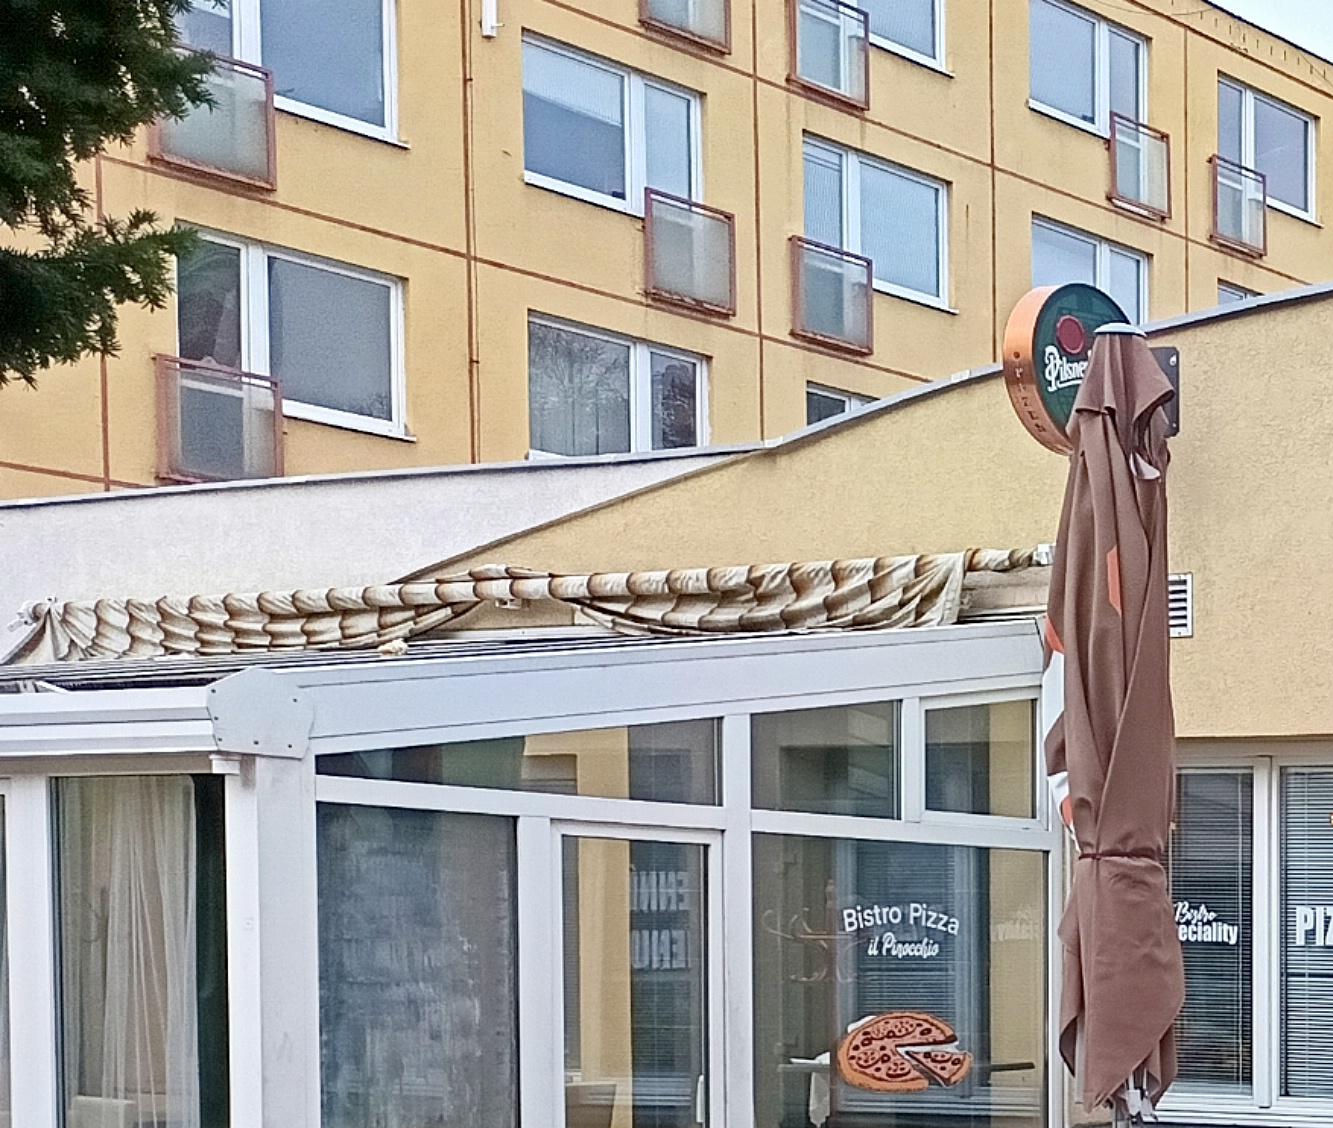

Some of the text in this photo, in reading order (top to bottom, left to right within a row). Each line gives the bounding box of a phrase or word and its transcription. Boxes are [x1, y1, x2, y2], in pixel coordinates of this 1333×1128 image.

[842, 904, 902, 932] Bistro
[909, 902, 960, 936] Pizza
[1173, 901, 1218, 924] Bistro
[867, 931, 940, 959] il Pinocchio
